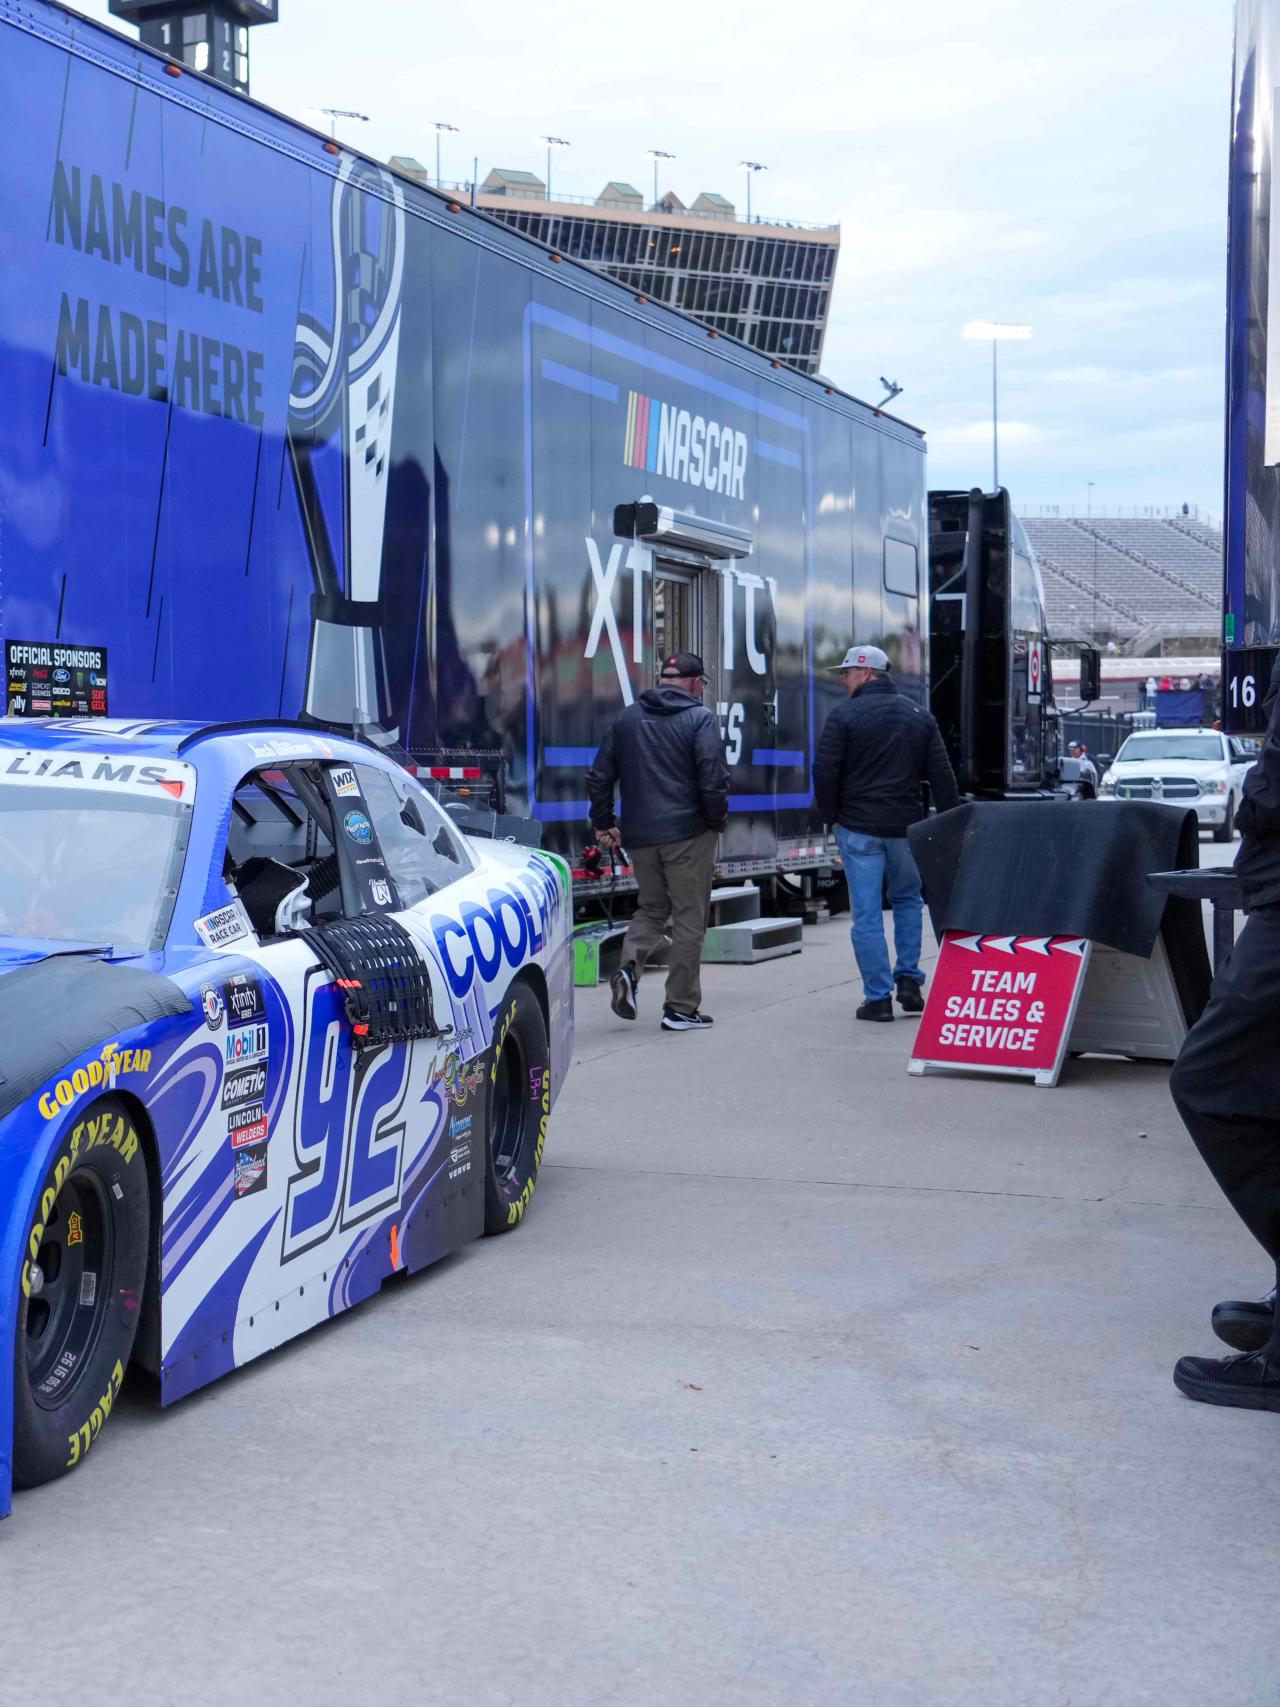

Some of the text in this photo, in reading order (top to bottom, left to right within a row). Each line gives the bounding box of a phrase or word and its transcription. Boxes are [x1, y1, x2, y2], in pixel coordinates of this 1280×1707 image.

[54, 160, 264, 313] NAMES ARE
[57, 291, 265, 429] MADE HERE
[656, 402, 748, 501] NASCAR
[10, 646, 101, 669] OFFICIAL SPONSORS
[1230, 675, 1256, 708] 16
[332, 771, 355, 788] WIX
[210, 922, 242, 944] RACE CAR
[971, 969, 1037, 995] TEAM
[230, 987, 256, 1014] xfinity
[945, 997, 1045, 1024] SALES &
[226, 1029, 254, 1060] Mobil
[938, 1023, 1039, 1051] SERVICE
[38, 1042, 152, 1120] GOODYEAR
[224, 1071, 266, 1101] COMETIC
[229, 1110, 261, 1129] LINCOLN
[236, 1124, 265, 1144] WELDERS
[66, 1358, 124, 1467] EAGLE
